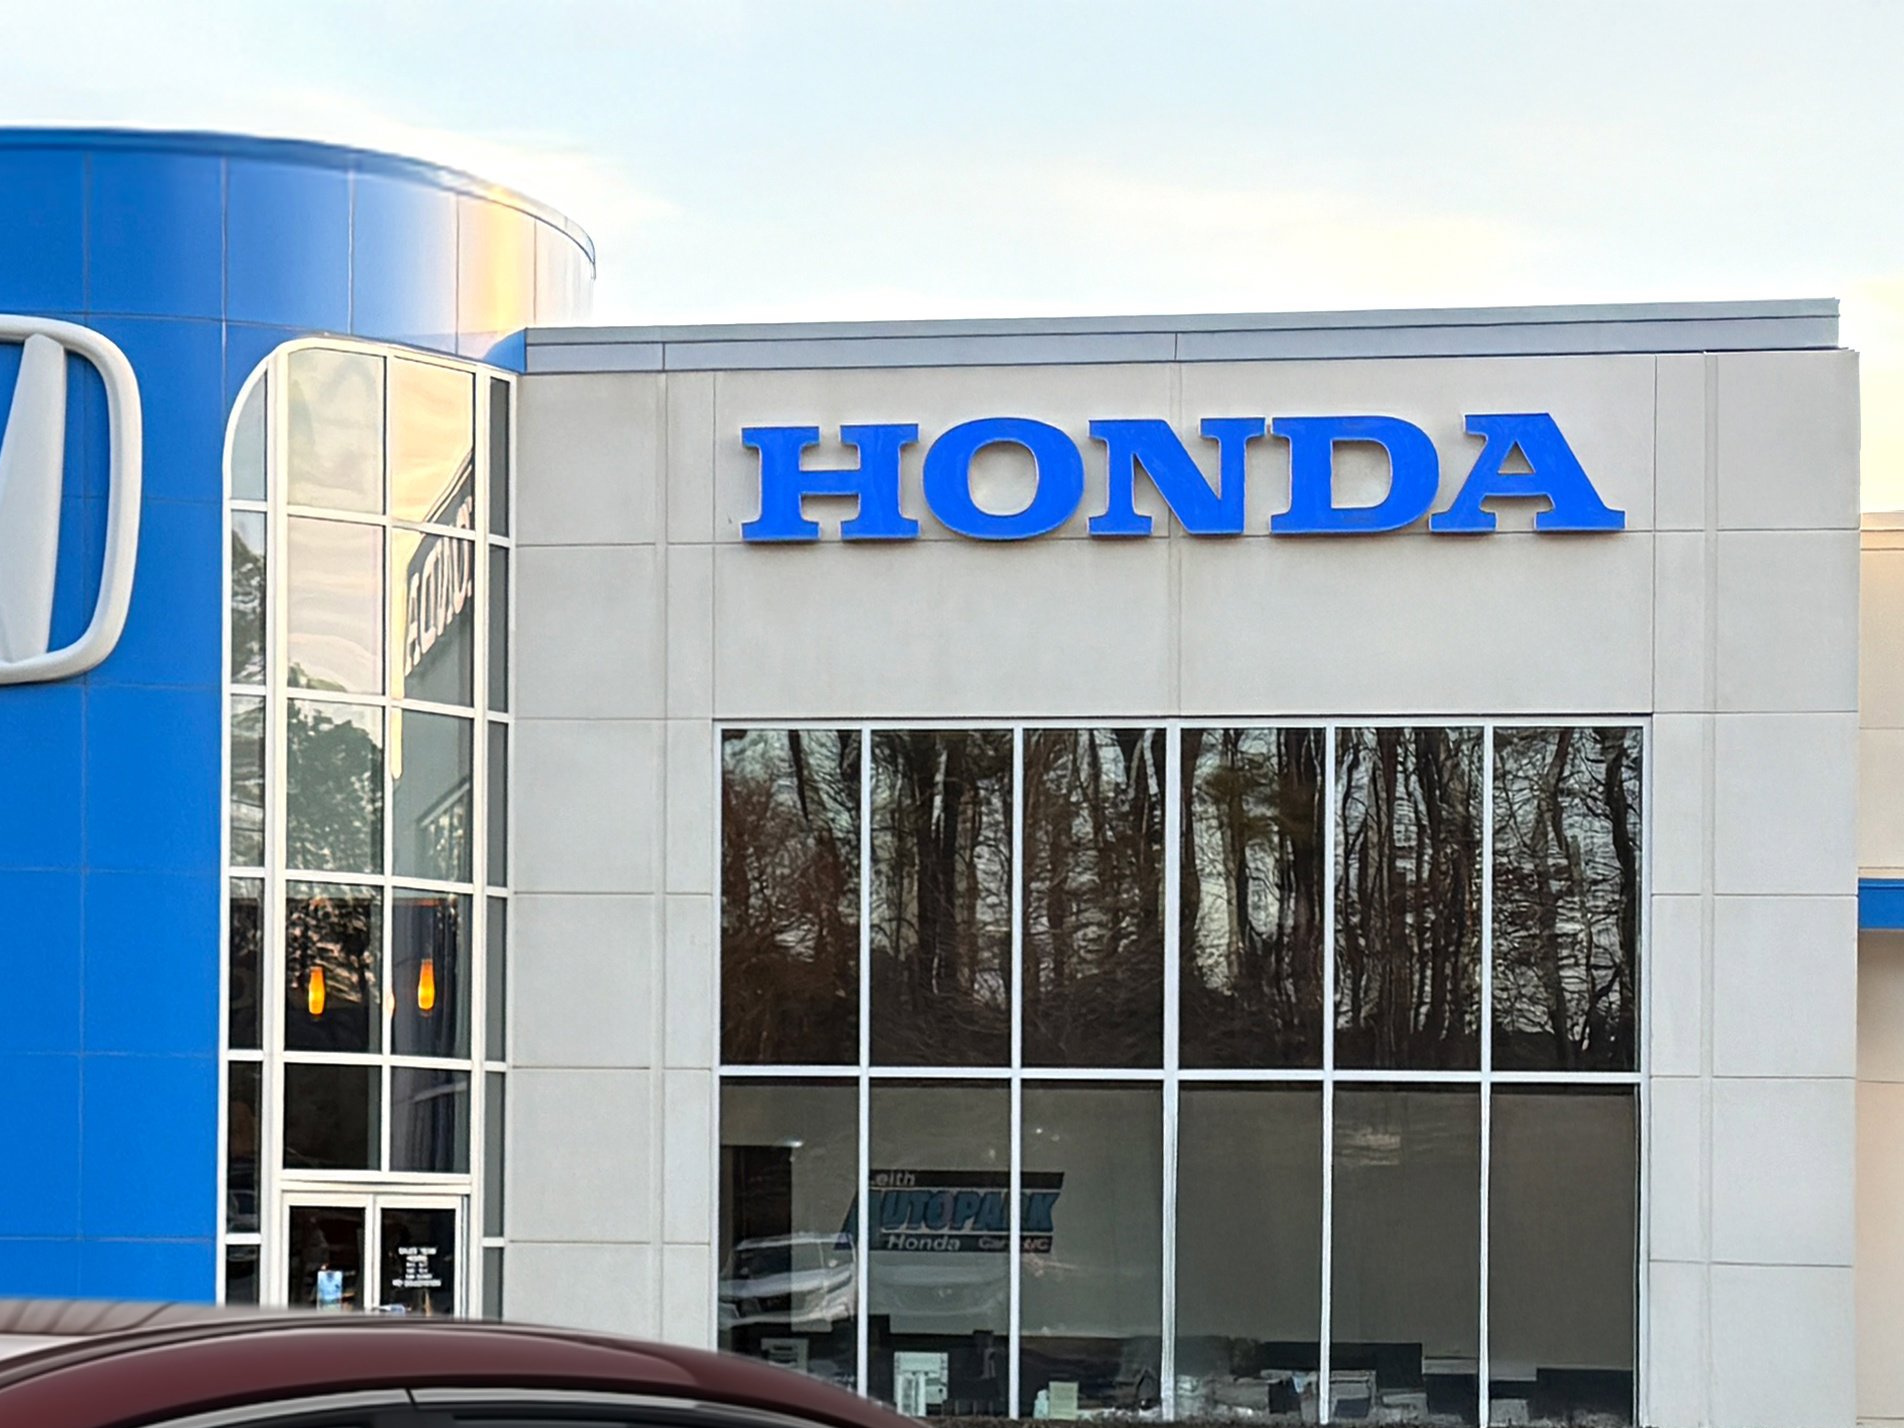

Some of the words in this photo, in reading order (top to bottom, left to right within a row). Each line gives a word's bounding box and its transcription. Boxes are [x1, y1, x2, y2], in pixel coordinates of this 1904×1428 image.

[741, 412, 1626, 541] HONDA
[870, 1169, 916, 1186] eith
[887, 1236, 961, 1250] Honda
